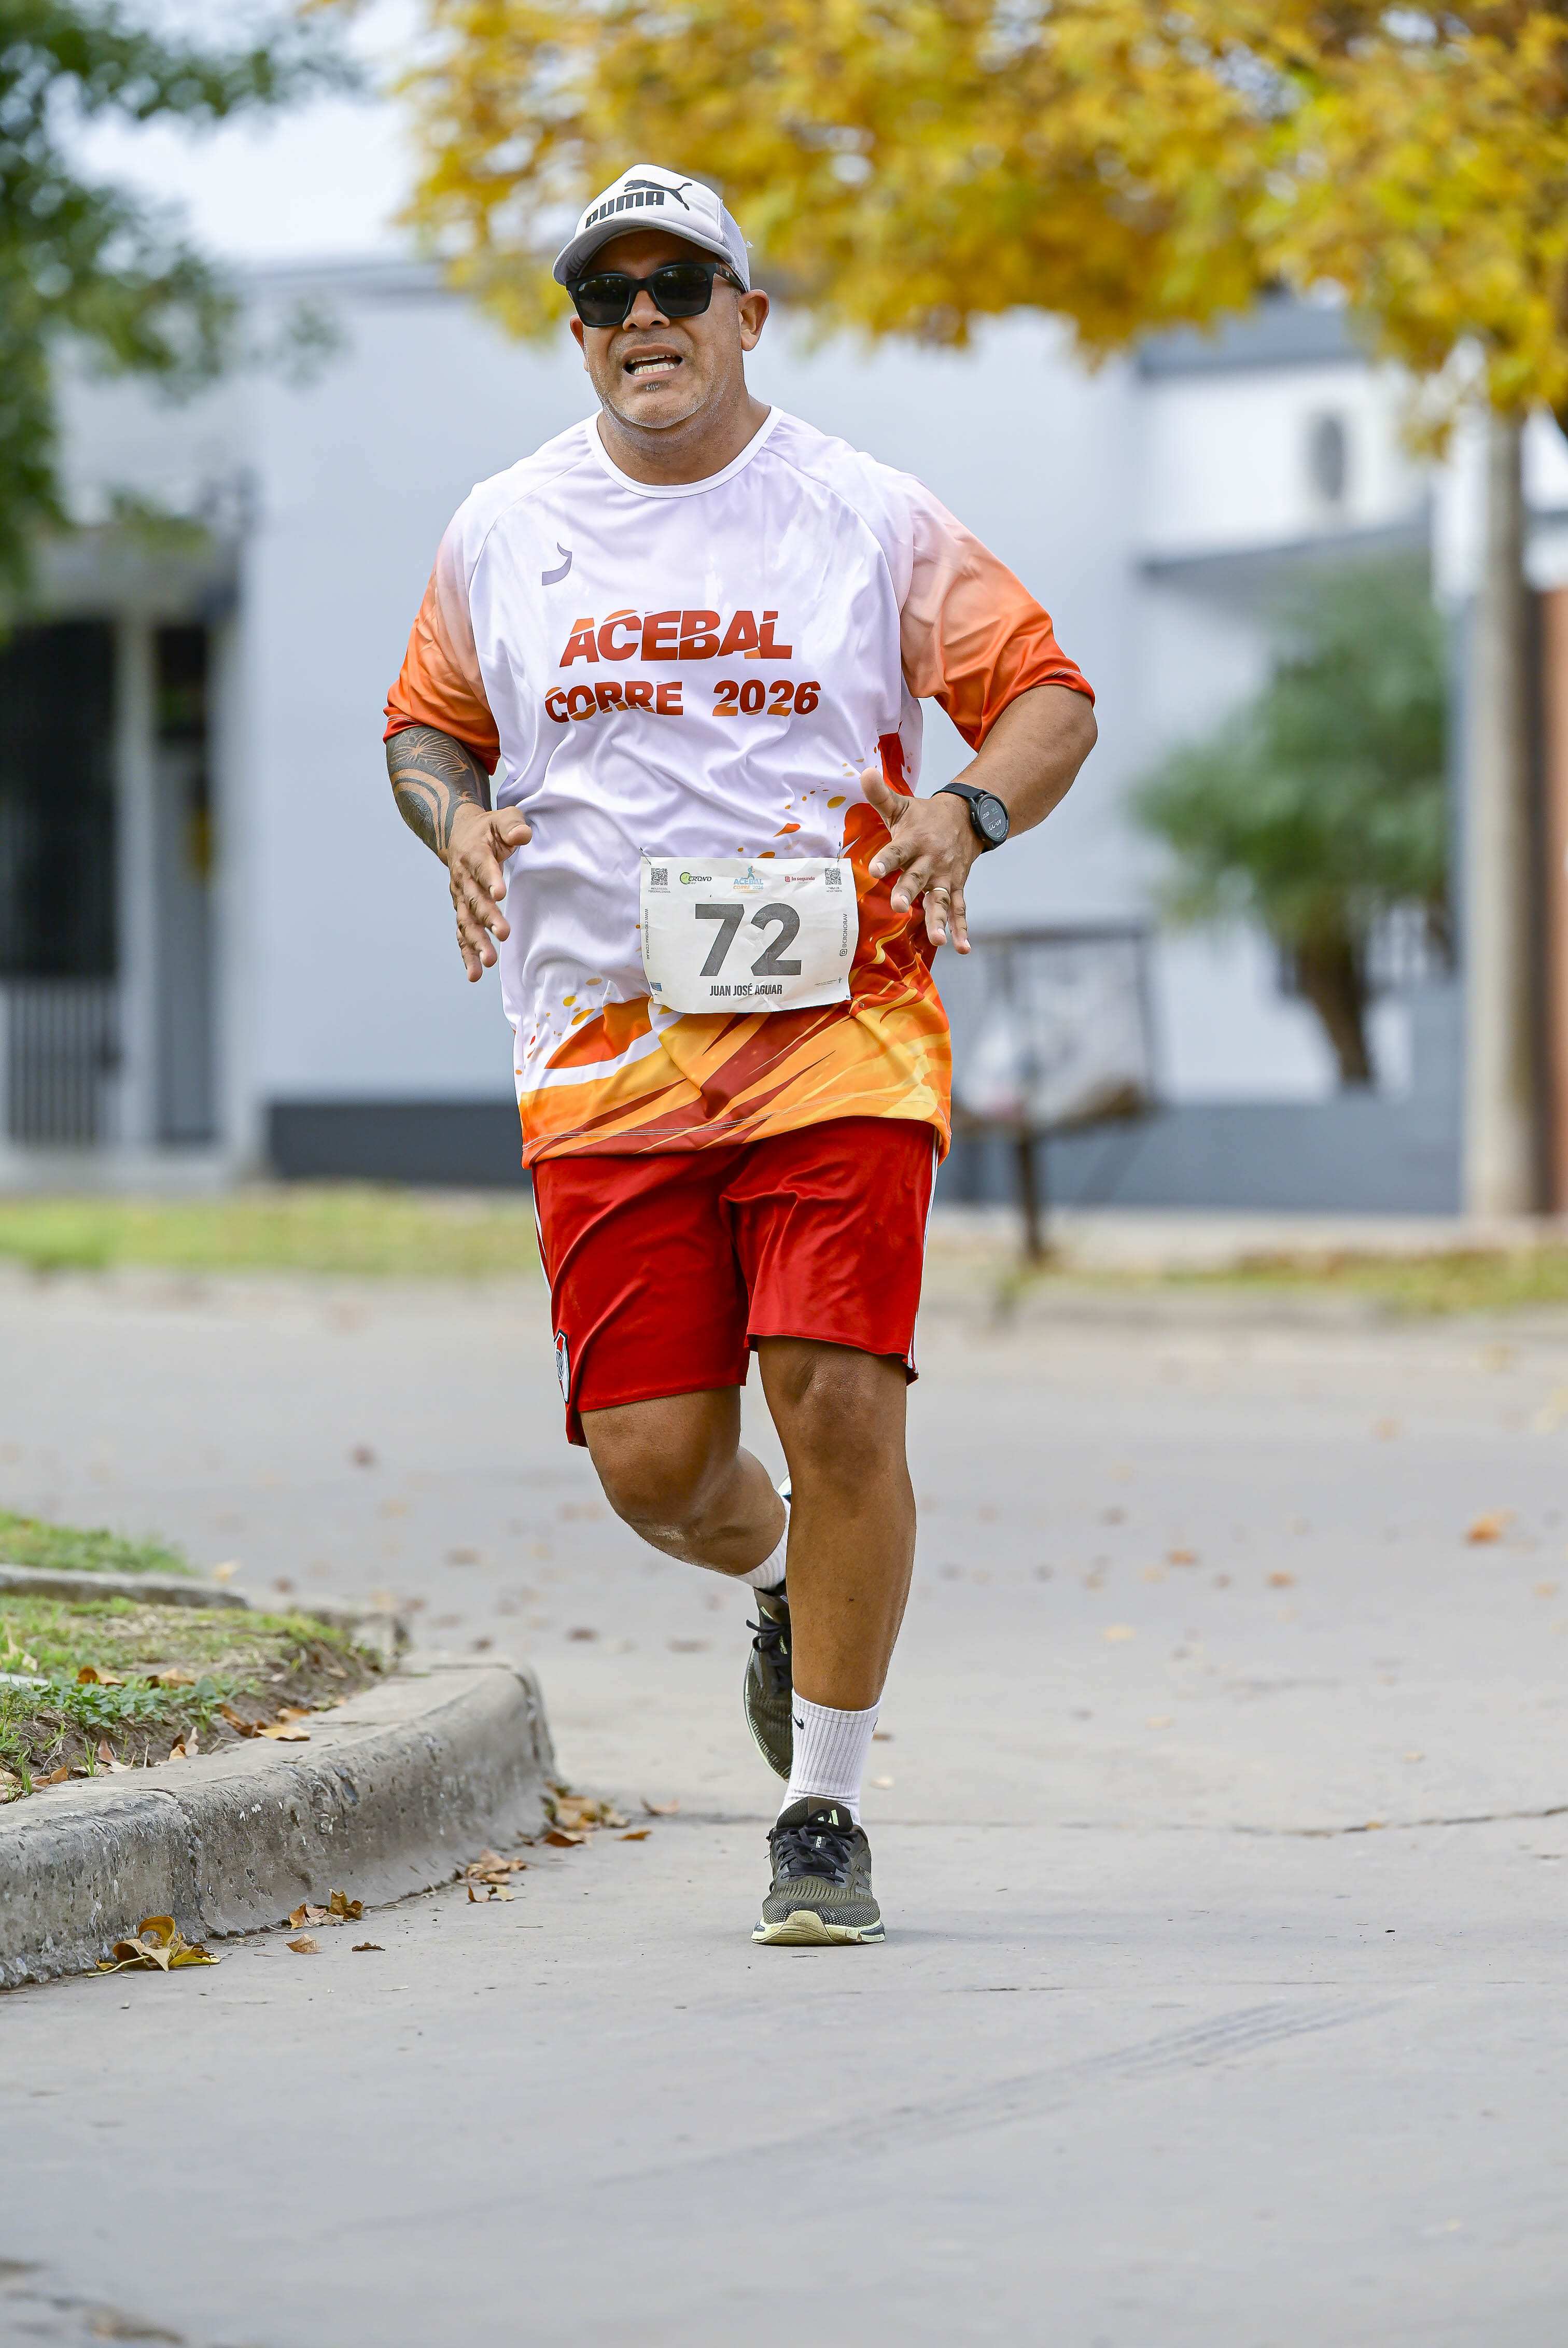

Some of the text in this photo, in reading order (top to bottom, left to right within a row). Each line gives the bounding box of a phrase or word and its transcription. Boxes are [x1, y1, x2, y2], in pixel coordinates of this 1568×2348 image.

[585, 191, 664, 229] PUMA
[559, 609, 793, 667] ACEBAL
[544, 679, 821, 723] CORRE 2026
[695, 903, 802, 976] 72
[709, 983, 782, 996] JUAN JOSÉ AGUIAR
